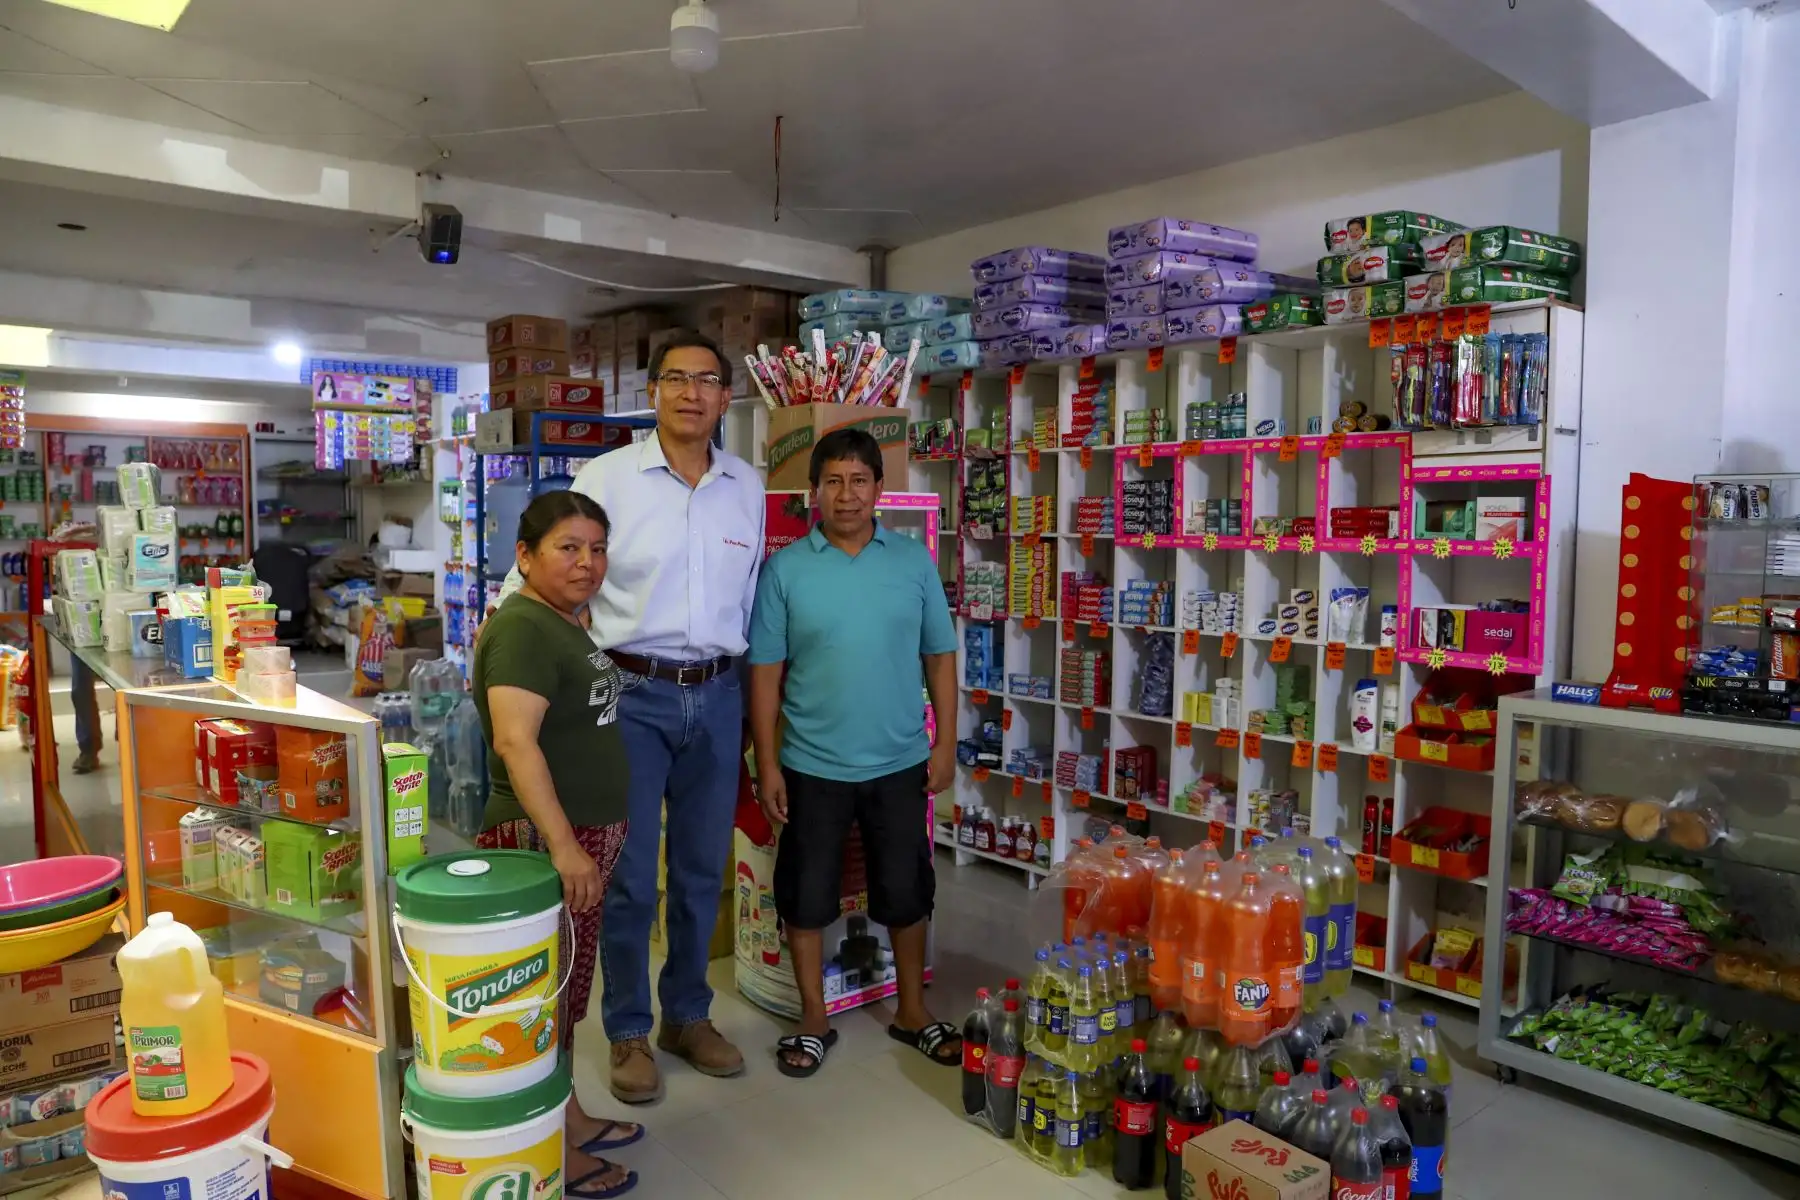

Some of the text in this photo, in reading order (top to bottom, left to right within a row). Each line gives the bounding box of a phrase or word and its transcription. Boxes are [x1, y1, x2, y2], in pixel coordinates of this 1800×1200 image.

[1073, 396, 1092, 404] Colgate
[1073, 410, 1092, 418] Colgate
[1063, 436, 1083, 444] Colgate
[1079, 497, 1102, 506] Colgate
[1751, 489, 1761, 518] casino
[1078, 507, 1102, 515] Colgate
[1077, 517, 1100, 525] Colgate
[1077, 525, 1100, 534] Colgate
[1079, 586, 1100, 594] Colgate
[1079, 595, 1100, 603] Colgate
[1078, 604, 1099, 612] Colgate
[1484, 628, 1512, 638] sedal
[1696, 677, 1717, 688] NIK
[1557, 685, 1594, 697] HALLS
[396, 780, 421, 793] Brite
[451, 958, 543, 1013] Tondero
[1233, 981, 1270, 1001] FANTA
[0, 1034, 33, 1050] LORIA
[135, 1035, 175, 1047] PRIMOR
[0, 1060, 28, 1074] ECHE
